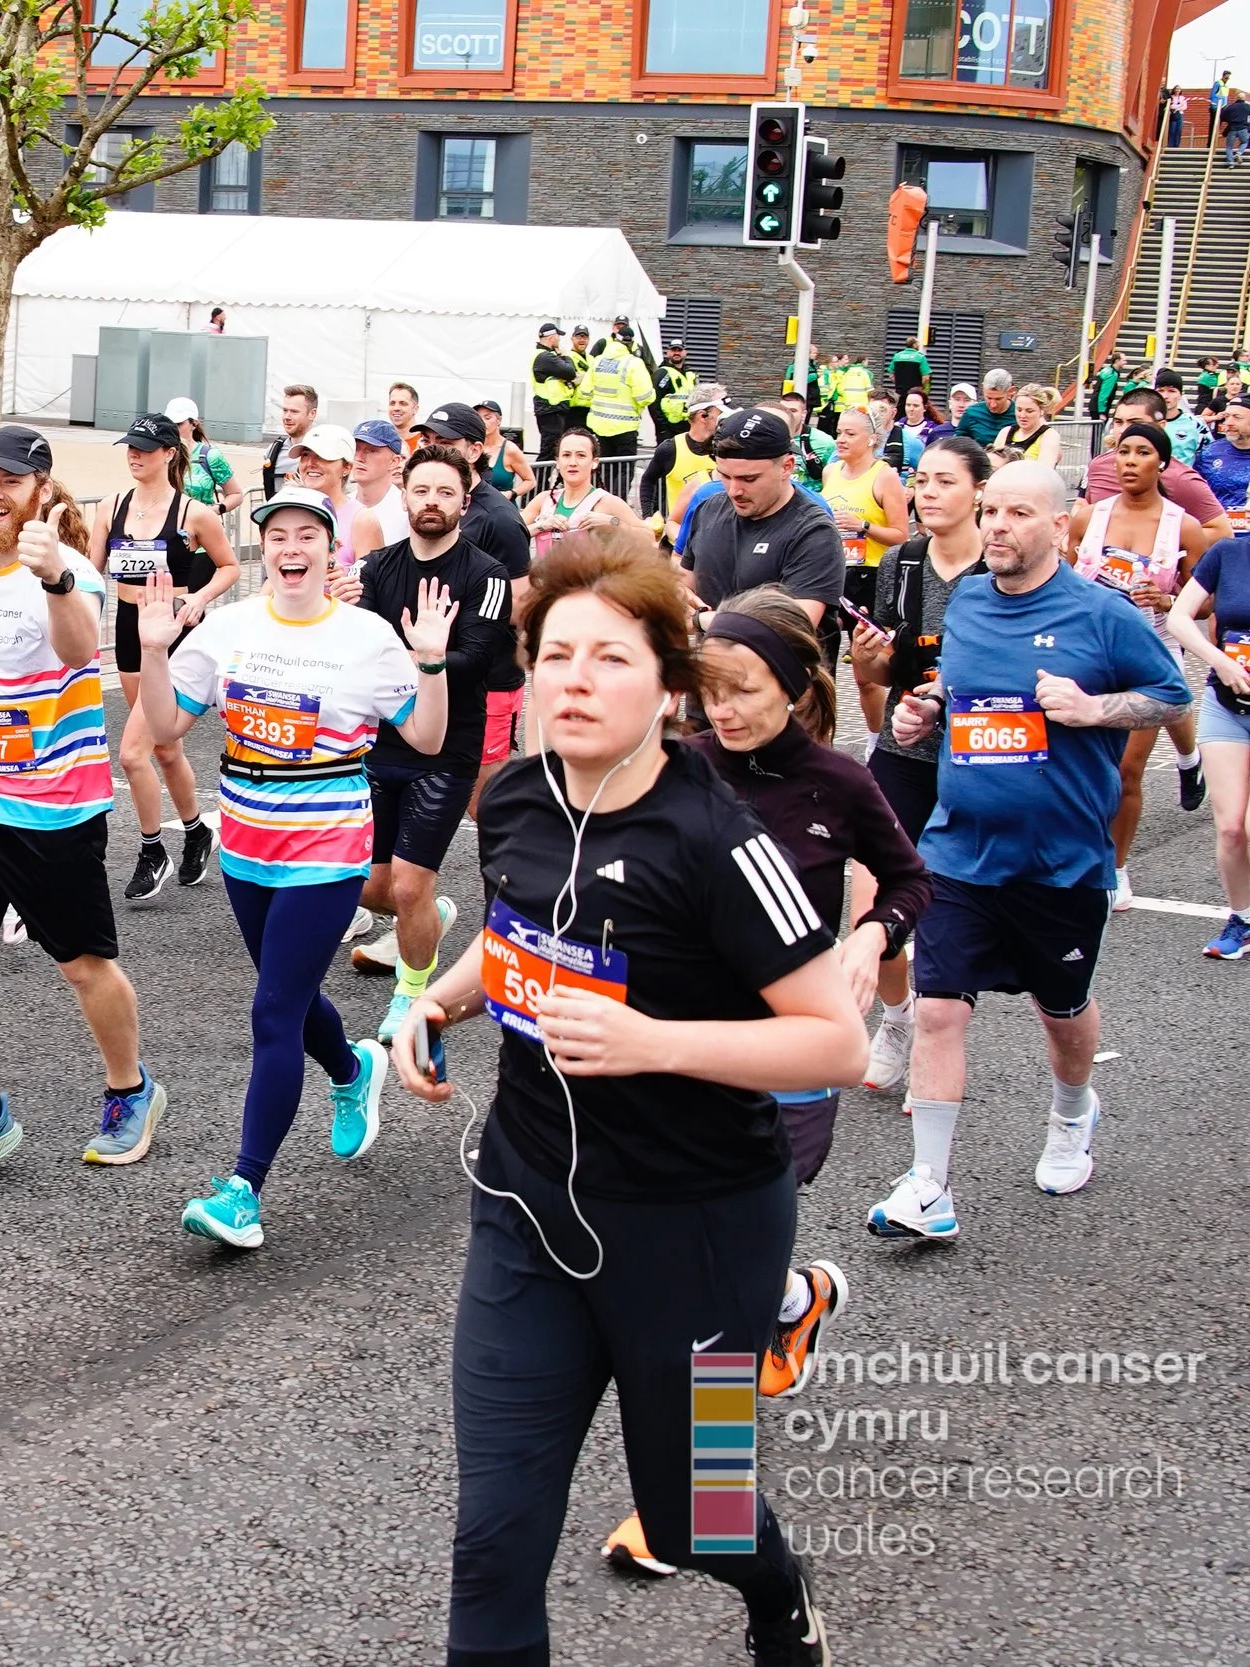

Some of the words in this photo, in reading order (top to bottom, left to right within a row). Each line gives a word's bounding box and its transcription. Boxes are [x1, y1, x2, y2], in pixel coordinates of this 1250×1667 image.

[957, 9, 1044, 55] COTT
[421, 33, 499, 55] SCOTT
[120, 559, 157, 572] 2722
[245, 661, 285, 677] cymru
[249, 650, 301, 667] ymchwil
[302, 659, 345, 672] canser
[266, 690, 301, 703] SWANSEA
[226, 701, 266, 718] BETHAN
[242, 715, 296, 746] 2393
[953, 717, 990, 727] BARRY
[968, 727, 1028, 750] 6065
[484, 936, 520, 969] ANYA
[540, 932, 594, 962] SWANSEA
[504, 968, 544, 1014] 59
[502, 1010, 545, 1041] #RUNS
